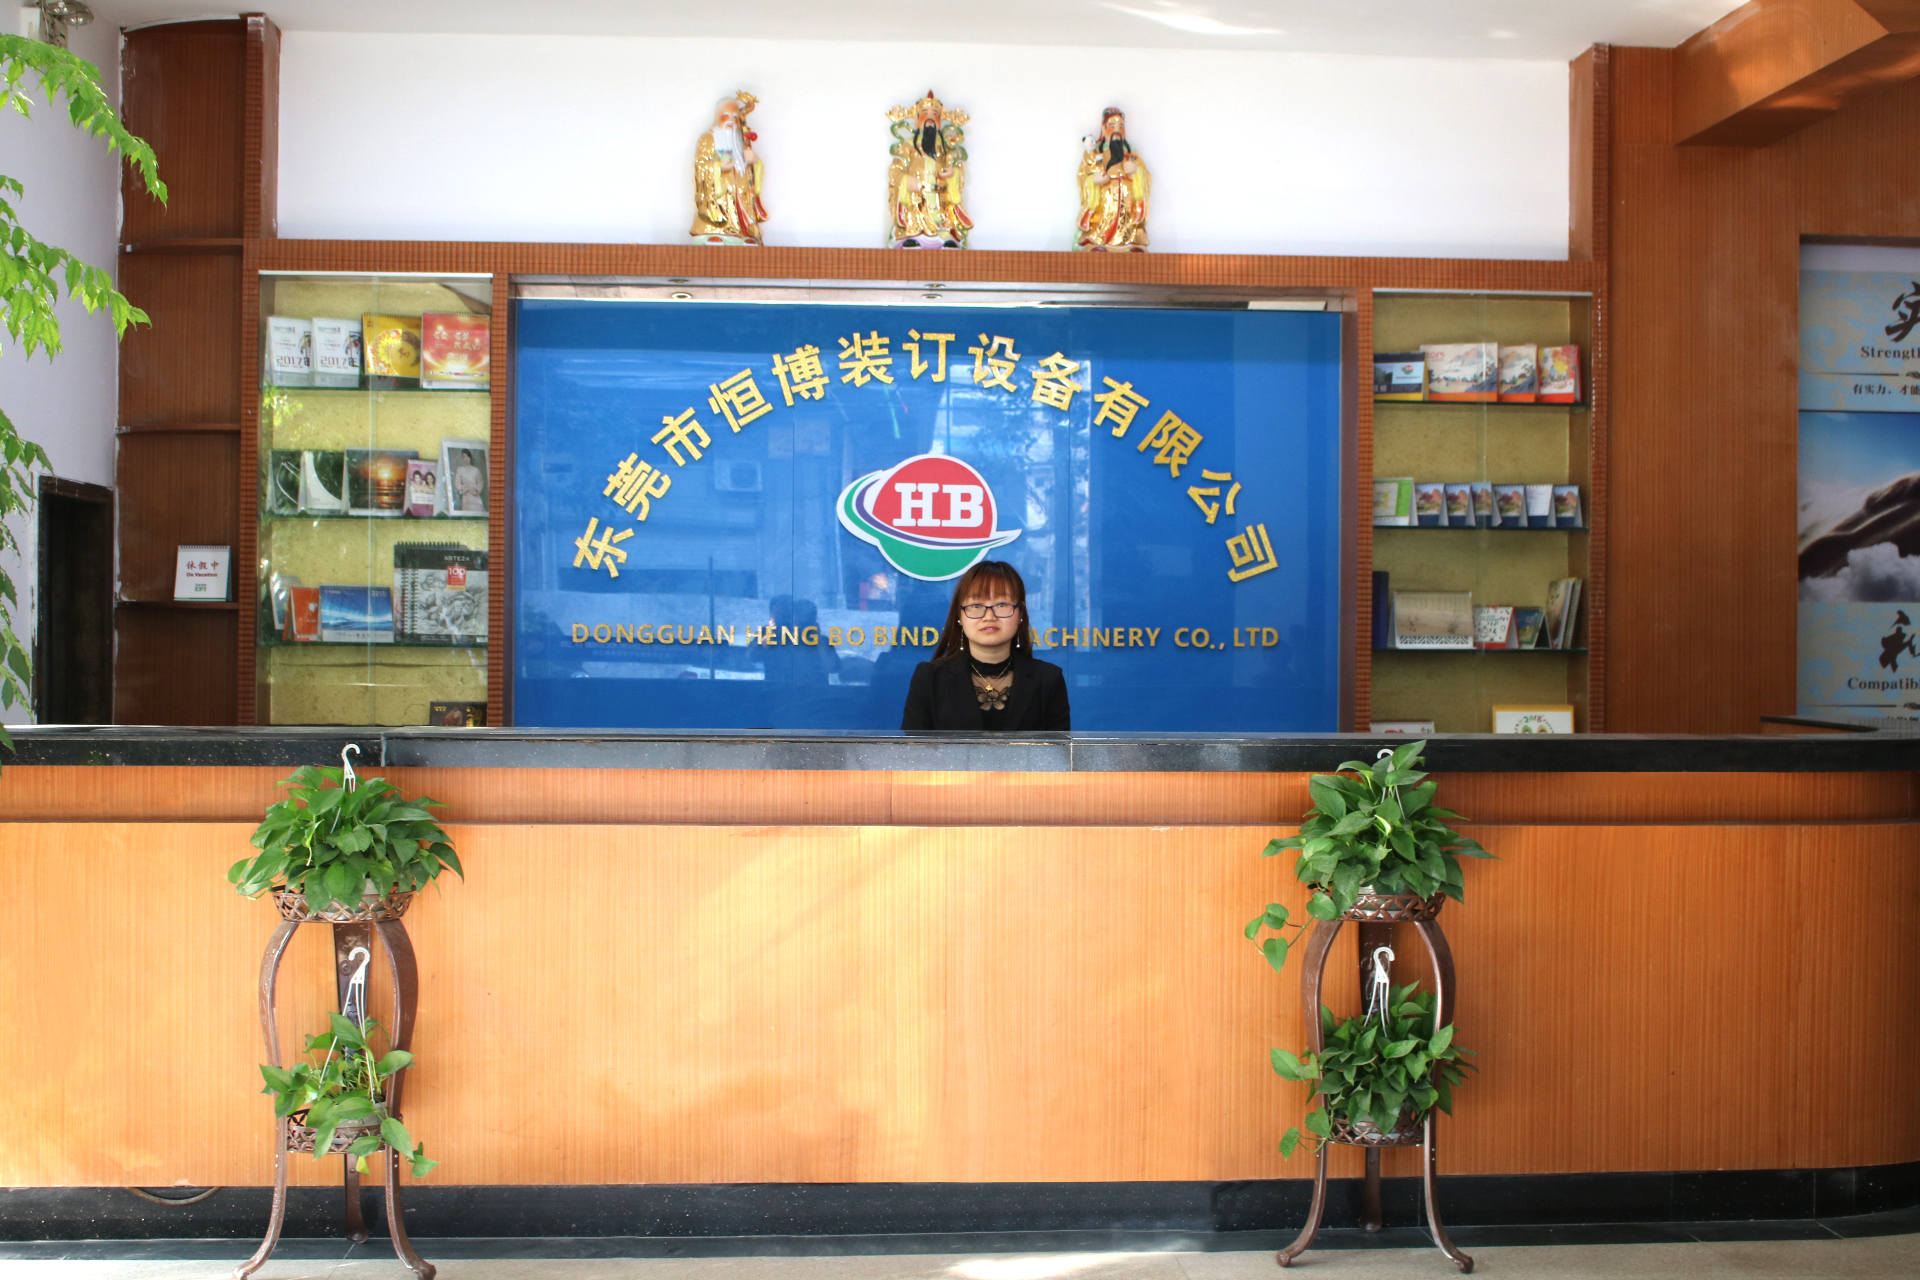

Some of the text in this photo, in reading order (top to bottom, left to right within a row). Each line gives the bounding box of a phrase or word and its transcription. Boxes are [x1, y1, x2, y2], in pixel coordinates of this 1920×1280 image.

[572, 328, 1279, 583] 东莞市恒博装订设备有限公司
[892, 483, 984, 528] HB
[186, 560, 220, 571] 休假中
[447, 567, 466, 576] 100
[572, 623, 1279, 650] DONGGUAN HENG BO BIND ACHINERY CO., LTD
[1847, 677, 1920, 692] Compatib
